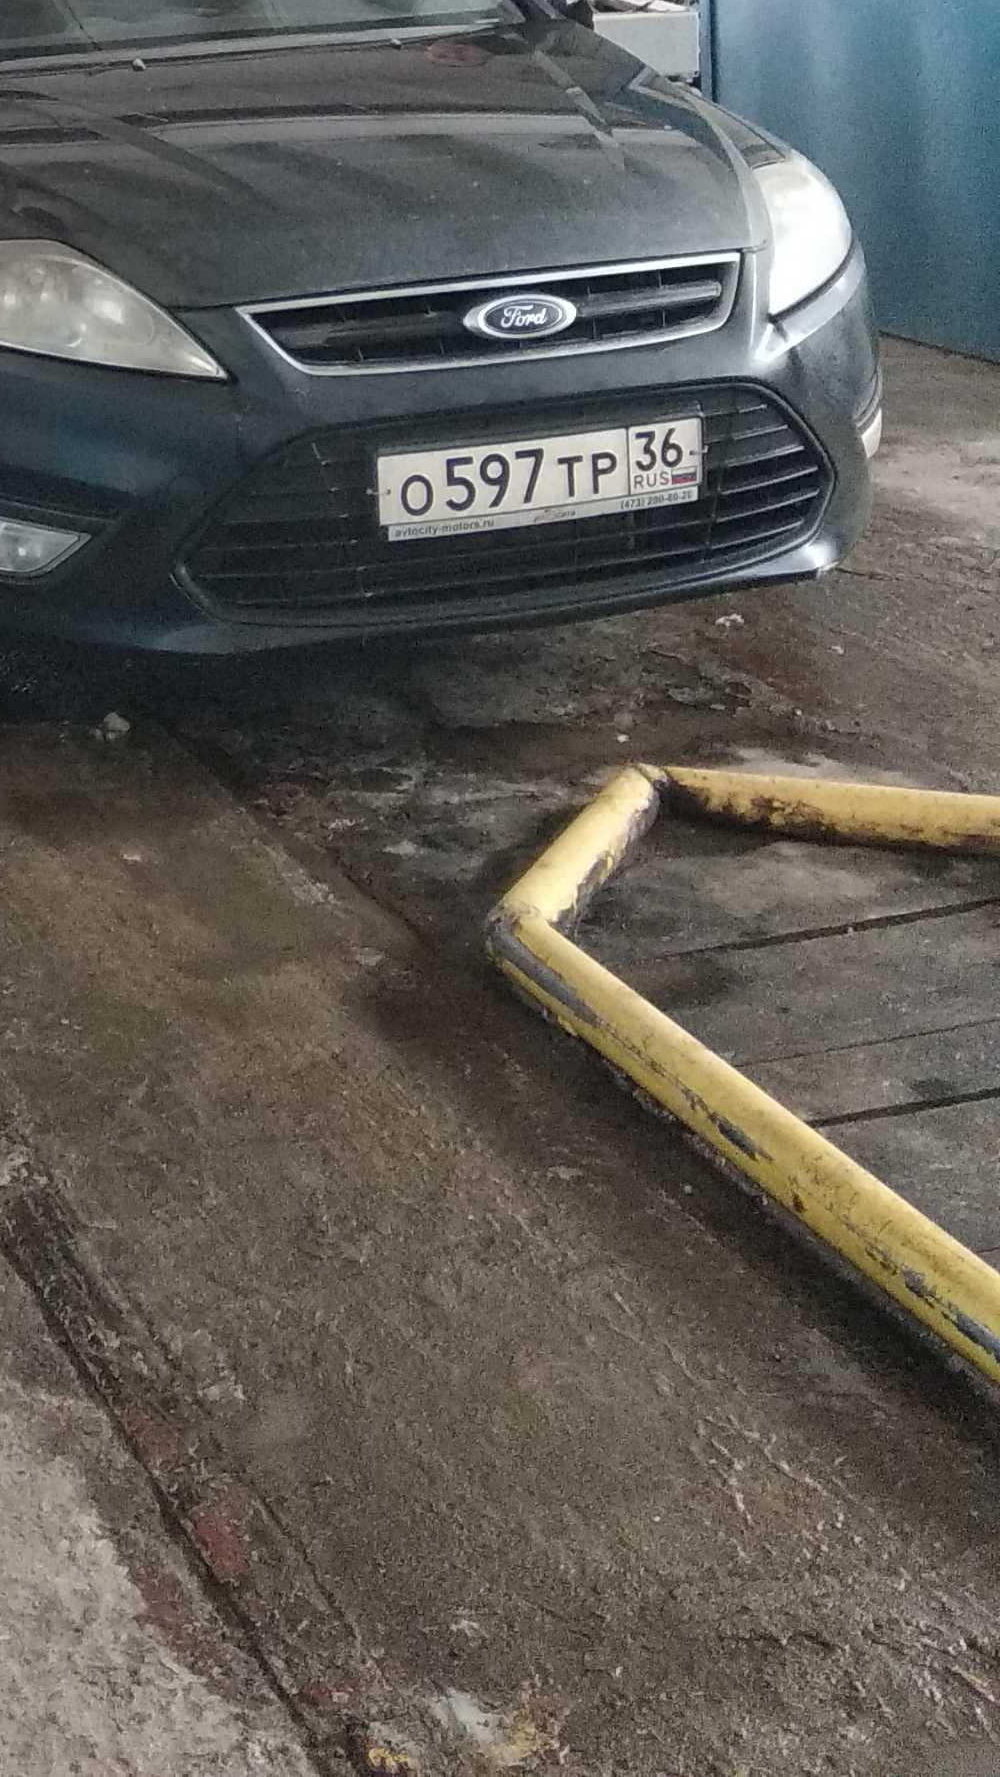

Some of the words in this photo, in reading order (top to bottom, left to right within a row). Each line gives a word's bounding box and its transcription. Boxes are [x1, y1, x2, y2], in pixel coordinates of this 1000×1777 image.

[501, 304, 548, 328] Ford
[633, 427, 684, 472] 36
[633, 471, 670, 490] RUS
